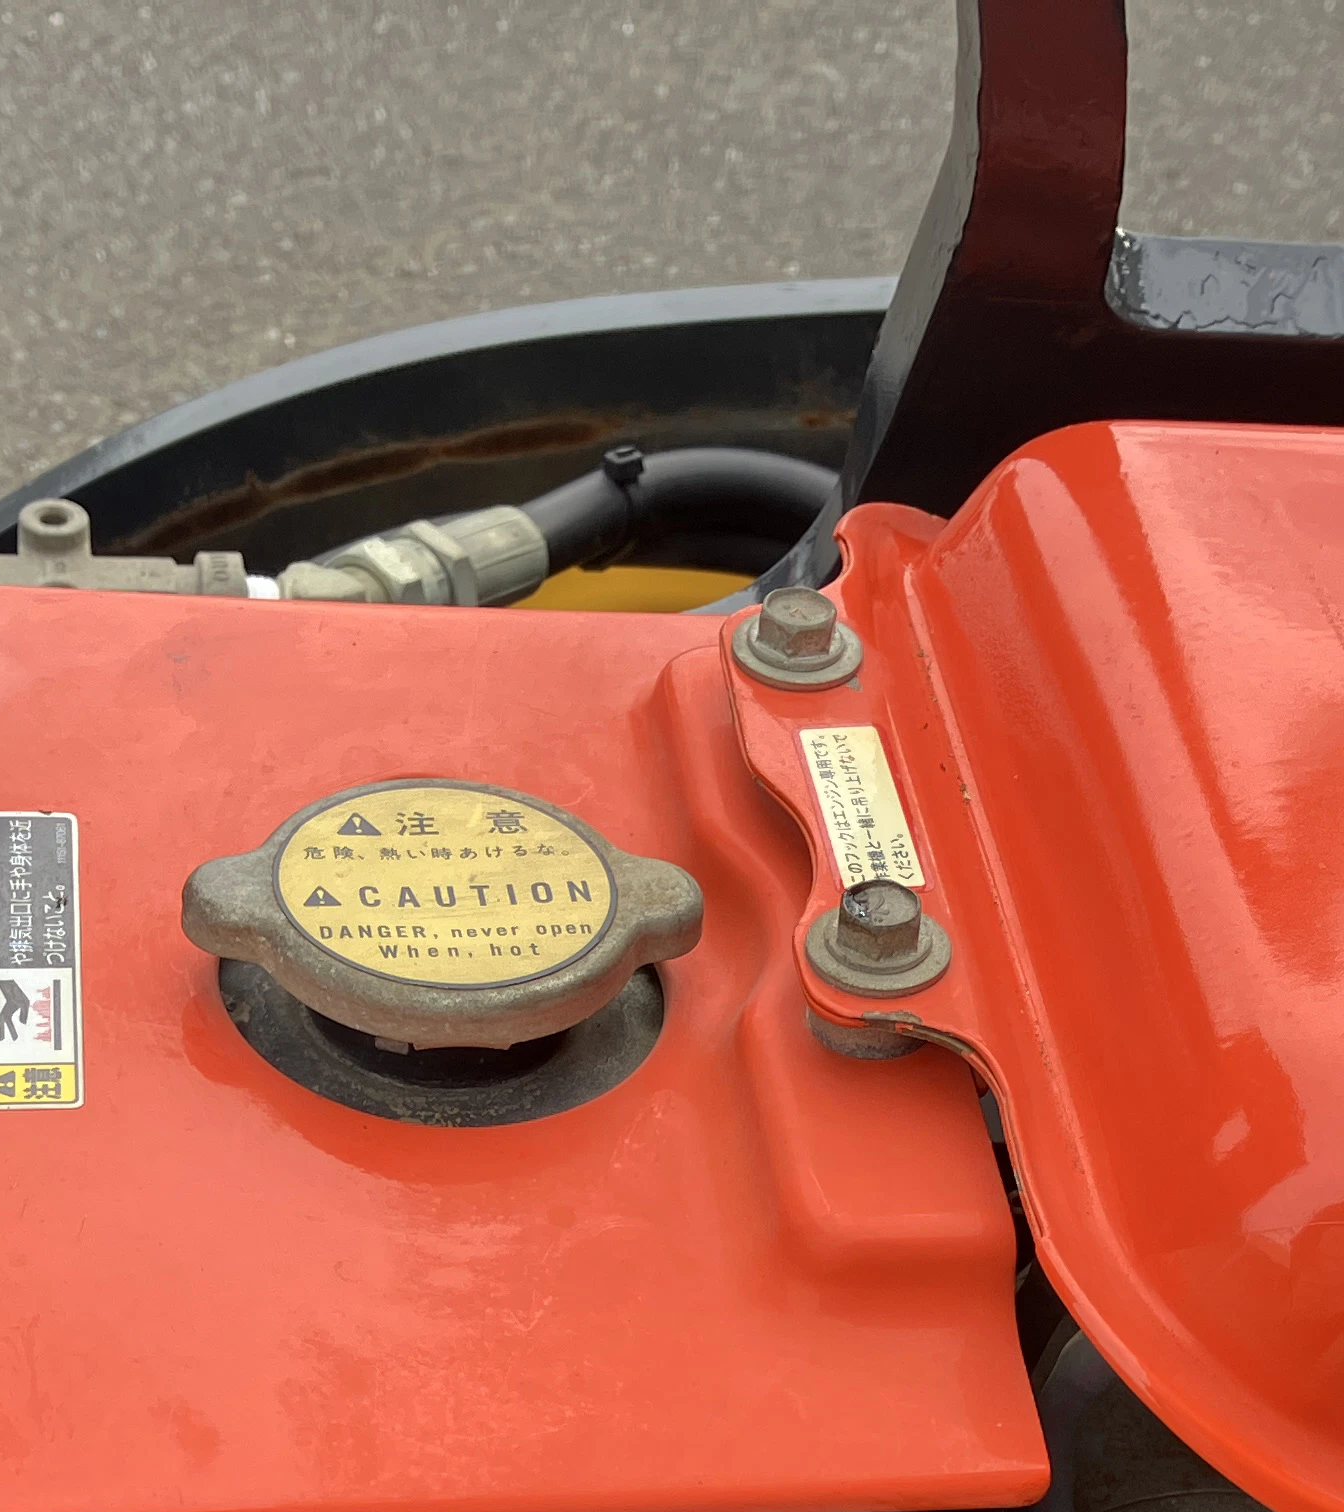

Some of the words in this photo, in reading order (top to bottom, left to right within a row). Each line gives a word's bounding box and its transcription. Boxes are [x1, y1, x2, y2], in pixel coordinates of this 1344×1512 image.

[809, 734, 867, 883] このフックはエンジン専用です。
[890, 833, 914, 880] ください。
[9, 819, 34, 965] や排気出口に手や身体を近
[358, 879, 594, 909] CAUTION
[319, 924, 439, 941] DANGER,
[450, 925, 520, 938] never
[536, 921, 594, 939] open
[379, 944, 474, 960] When,
[490, 942, 541, 958] hot
